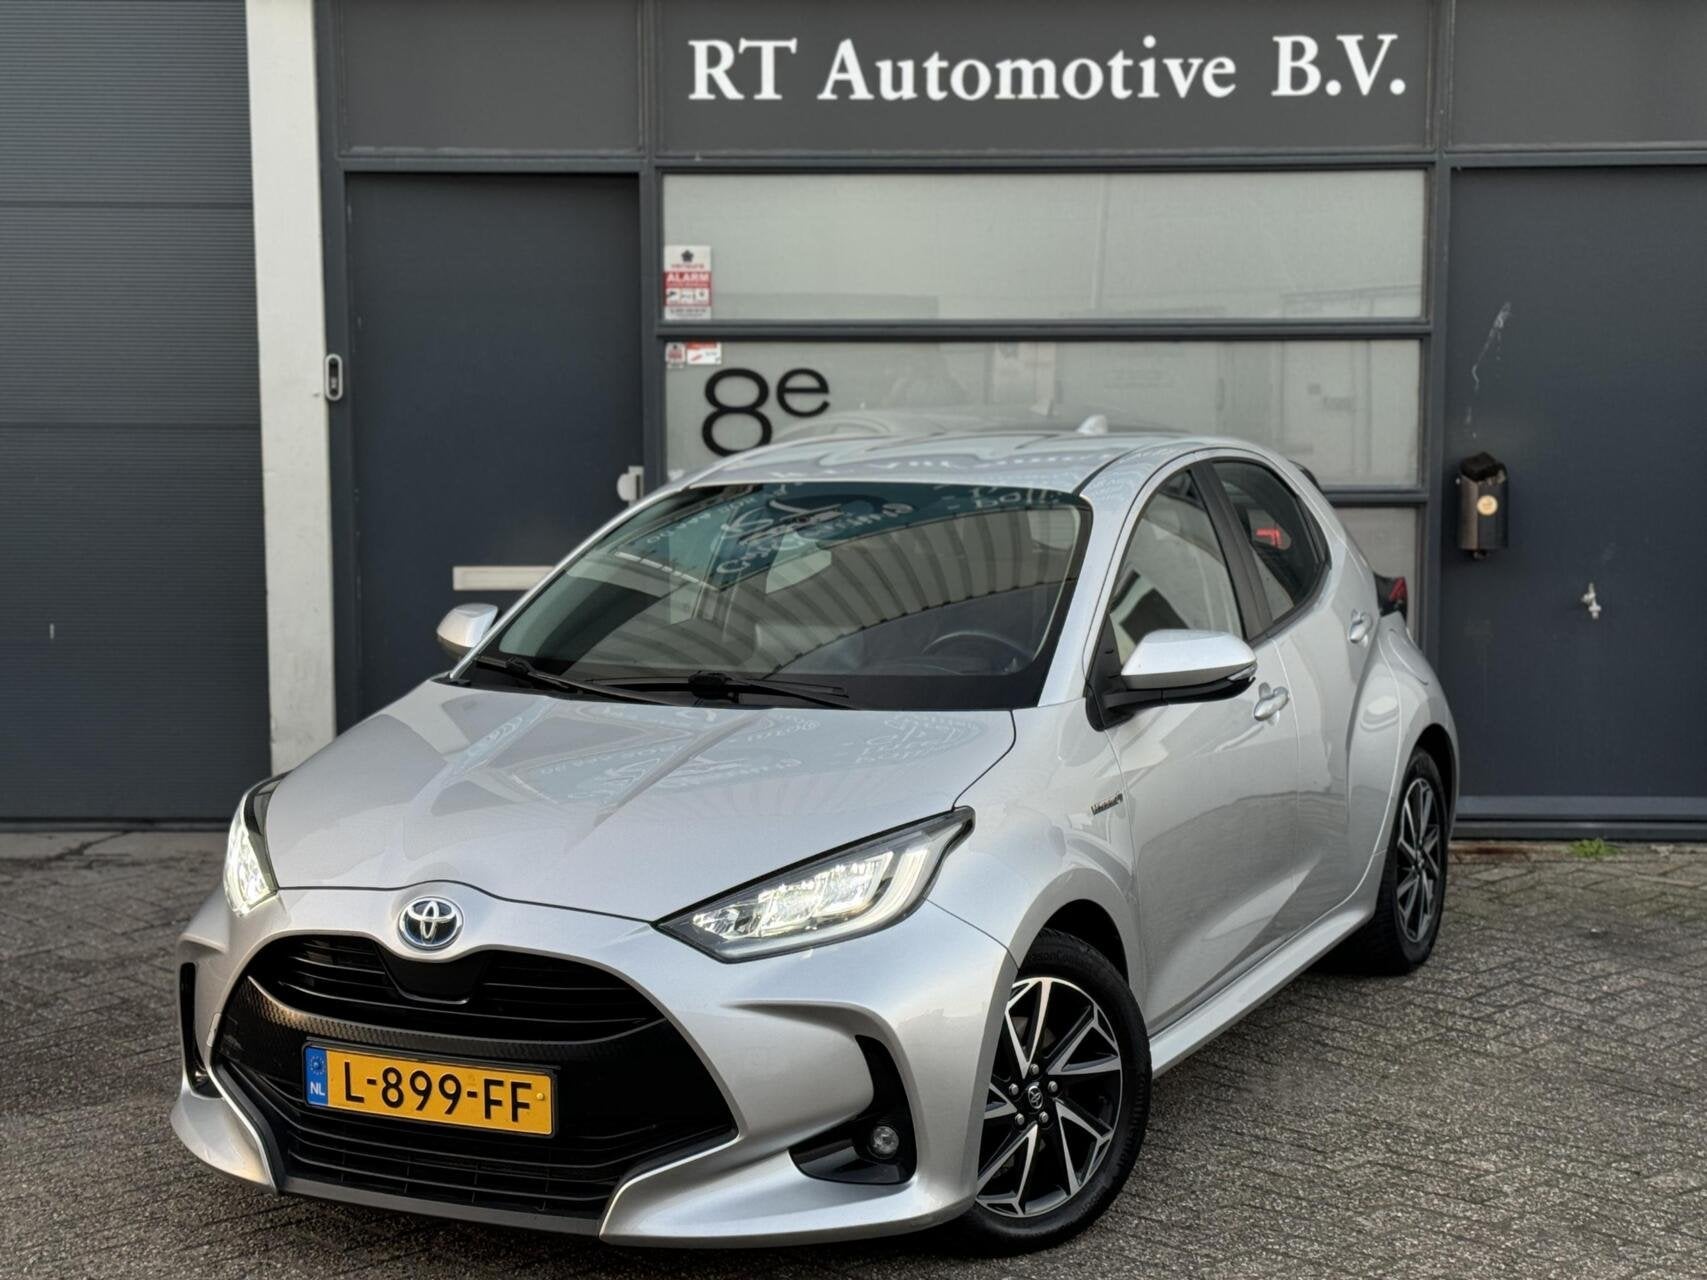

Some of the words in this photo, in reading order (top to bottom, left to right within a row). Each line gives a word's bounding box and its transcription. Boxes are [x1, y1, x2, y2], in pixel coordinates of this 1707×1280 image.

[688, 38, 798, 102] RT
[816, 35, 1238, 102] Automotive
[1270, 33, 1408, 98] B.V.
[667, 272, 709, 282] ALARM
[702, 368, 829, 457] 8e
[309, 1080, 326, 1097] NL
[344, 1062, 532, 1122] L-899-FF
